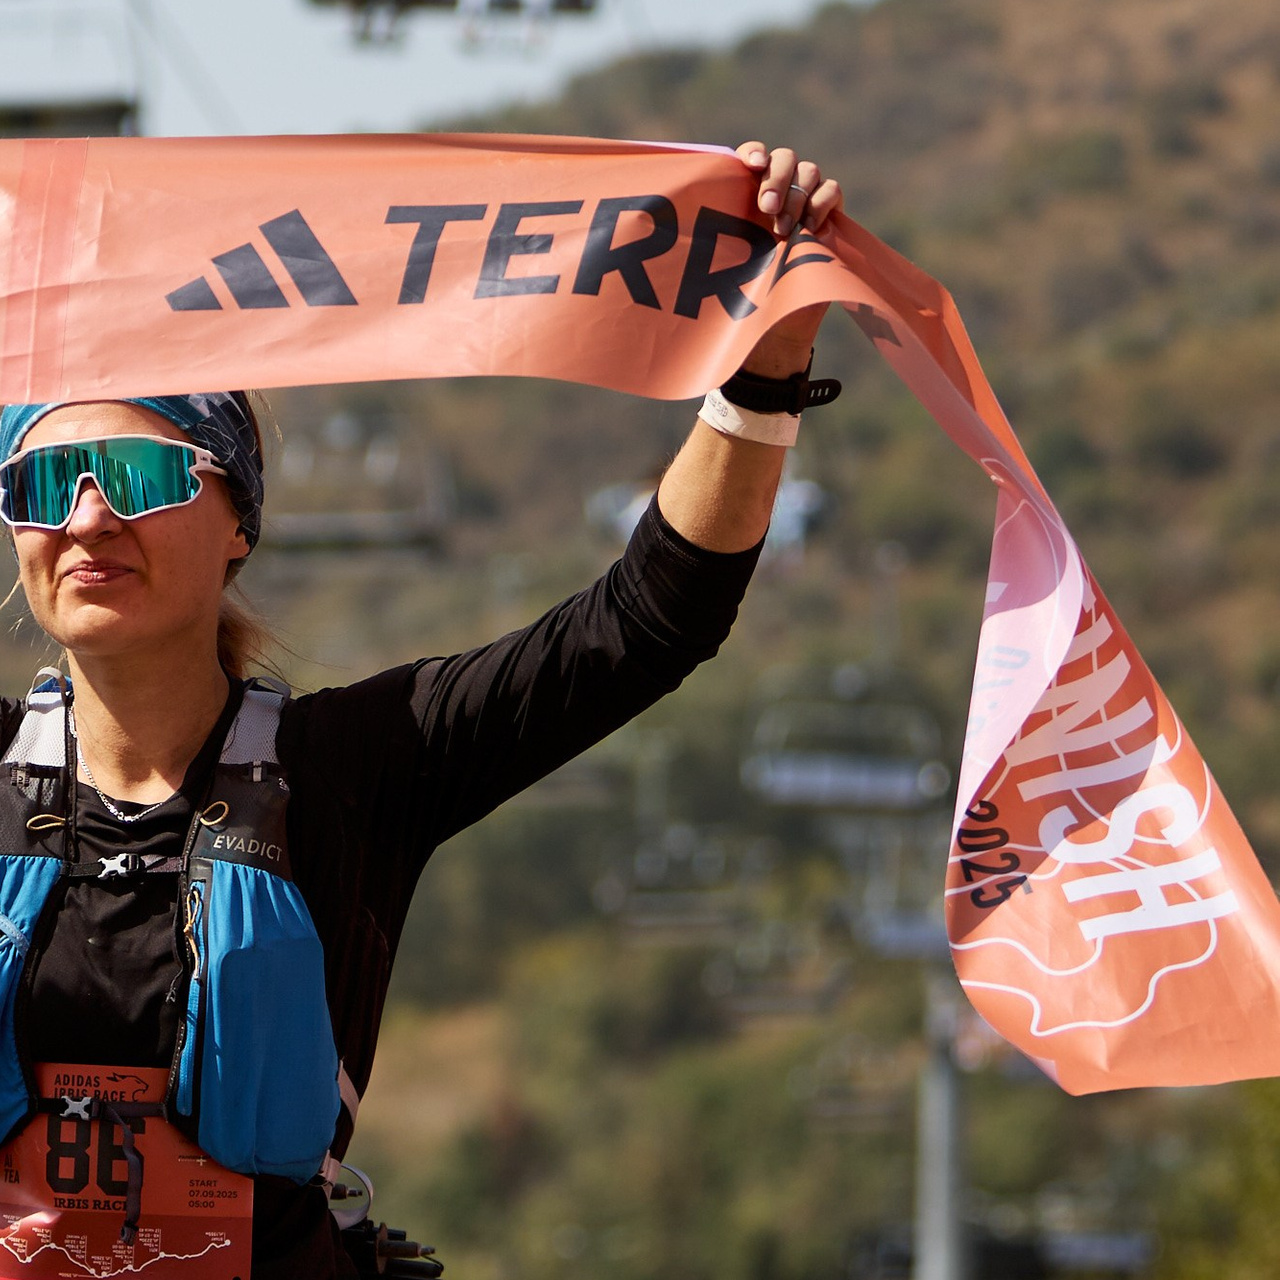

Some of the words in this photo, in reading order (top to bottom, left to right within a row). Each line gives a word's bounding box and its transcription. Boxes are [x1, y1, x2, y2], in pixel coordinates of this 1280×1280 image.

[213, 835, 282, 861] EVADICT
[54, 1074, 101, 1087] ADIDAS
[93, 1089, 127, 1102] RACE
[46, 1115, 146, 1197] 86
[189, 1179, 218, 1187] START
[189, 1190, 238, 1199] 07.09.2025
[54, 1197, 89, 1210] IRBIS
[189, 1200, 215, 1208] 05:00
